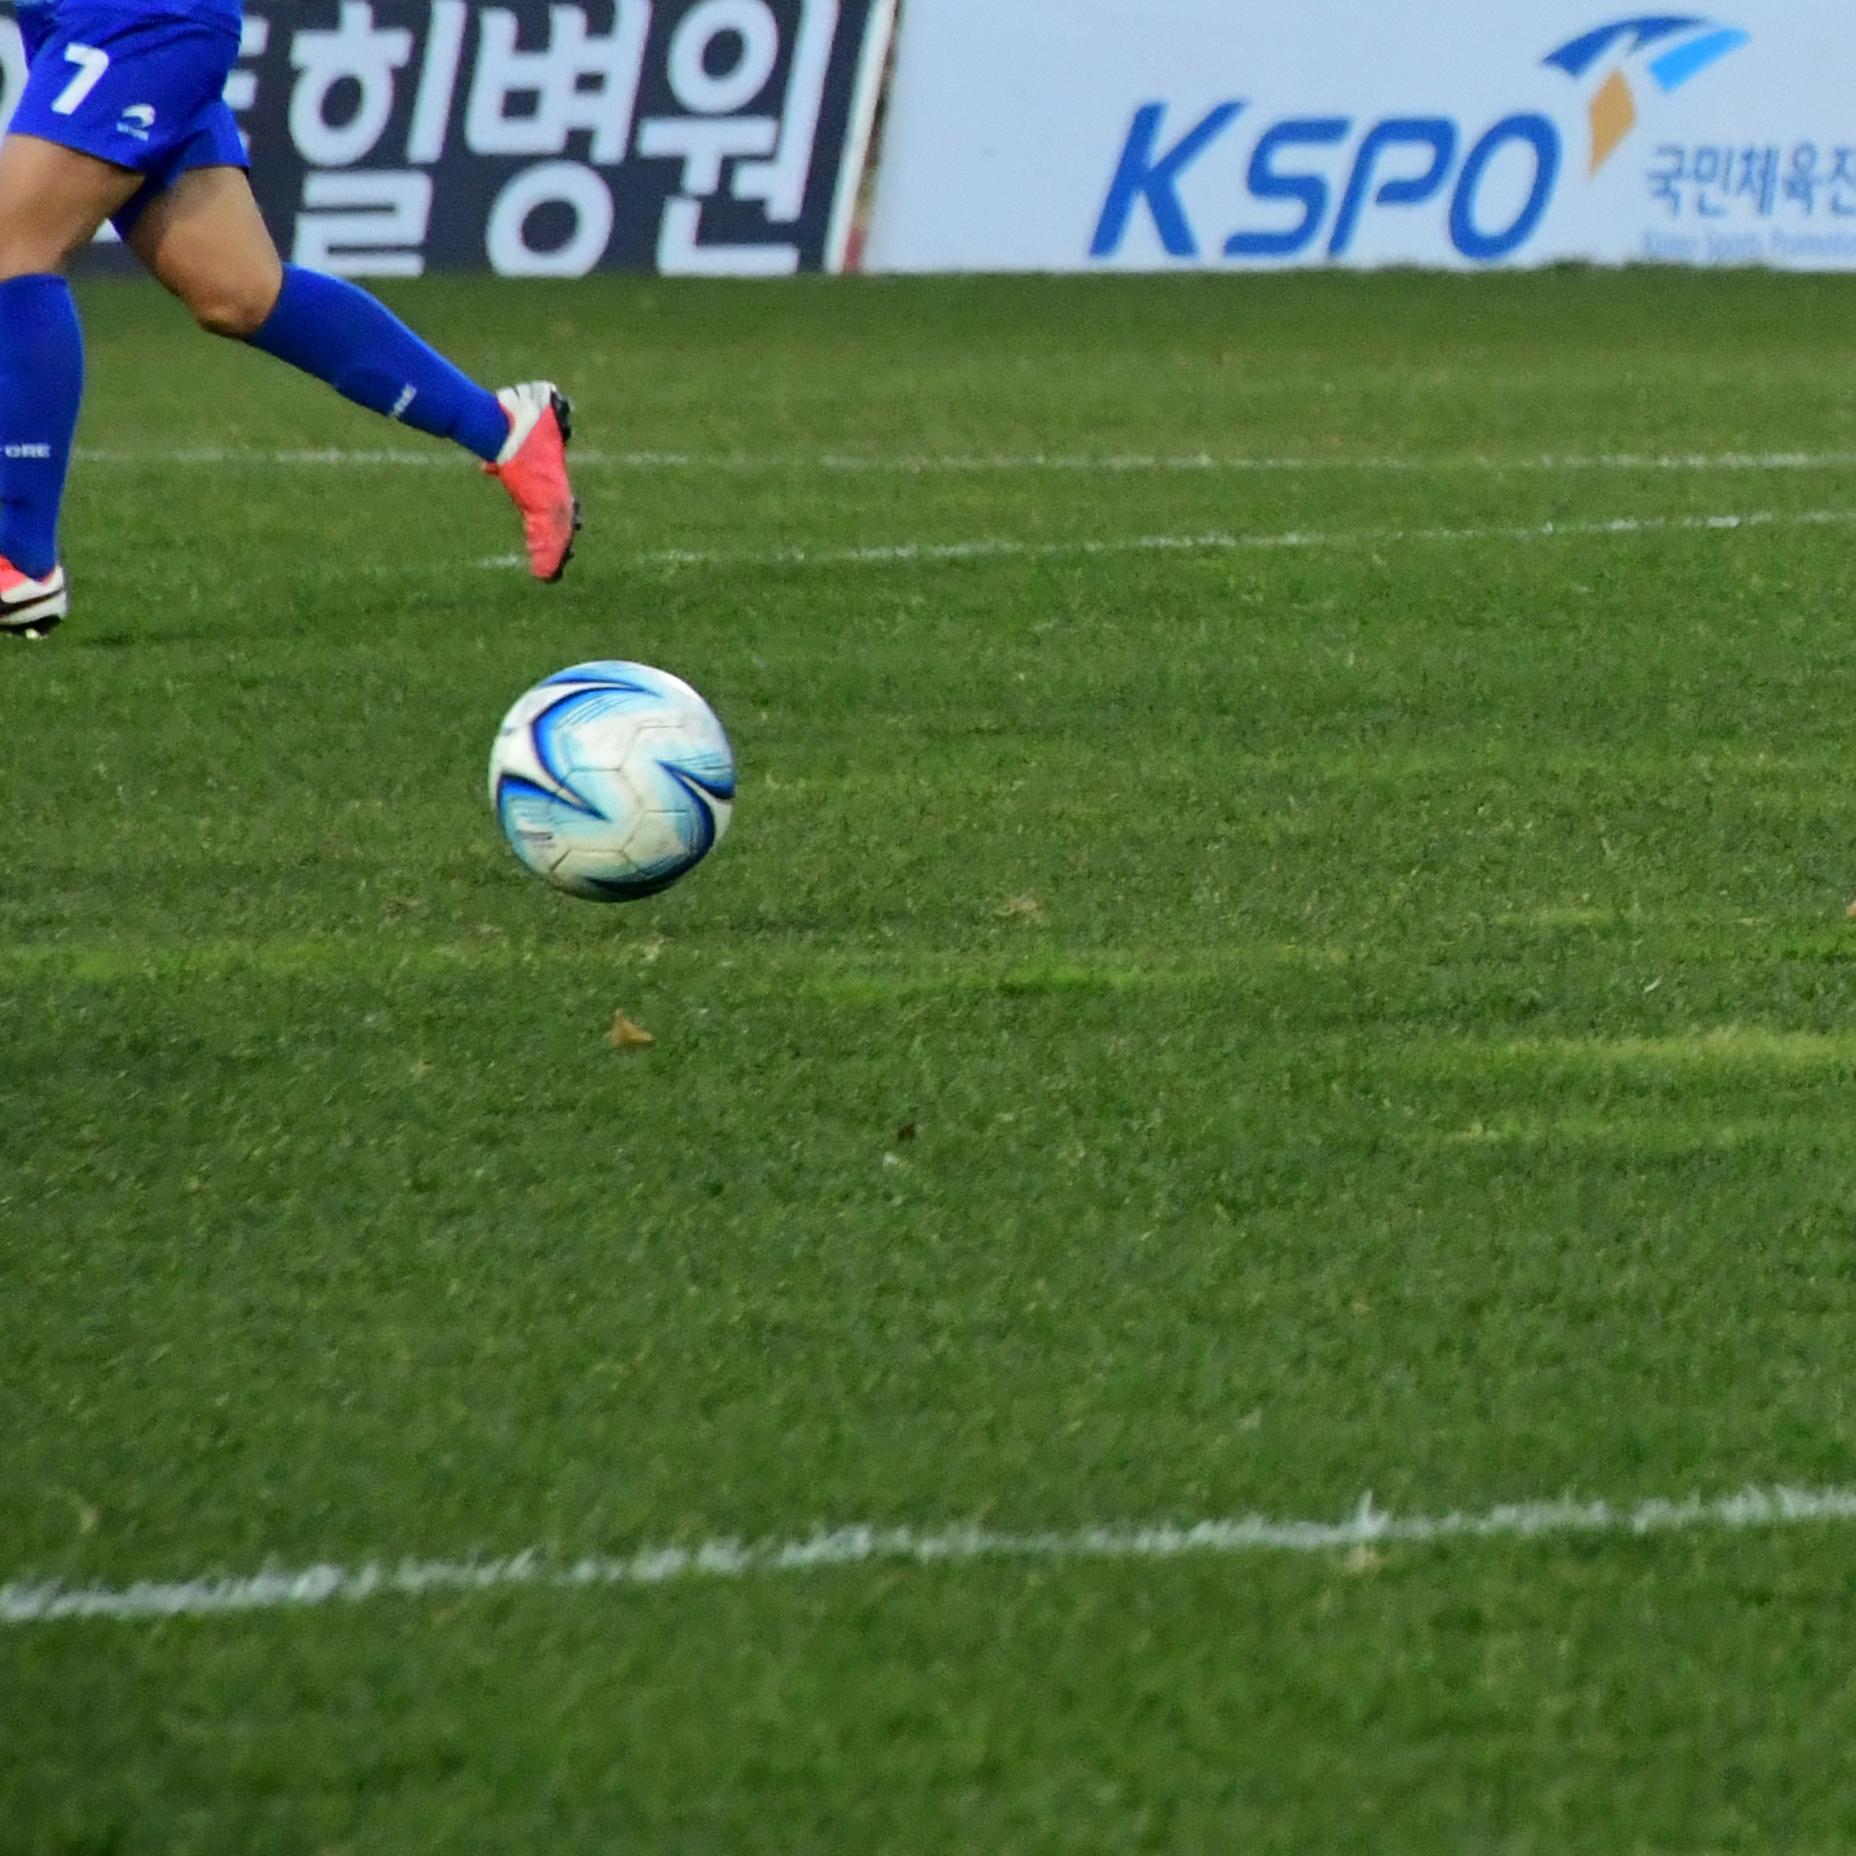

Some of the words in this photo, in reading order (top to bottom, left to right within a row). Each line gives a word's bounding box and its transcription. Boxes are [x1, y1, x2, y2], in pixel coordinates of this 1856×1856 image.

[51, 42, 109, 115] 7
[1088, 101, 1563, 261] KSPO
[0, 443, 50, 458] ORE
